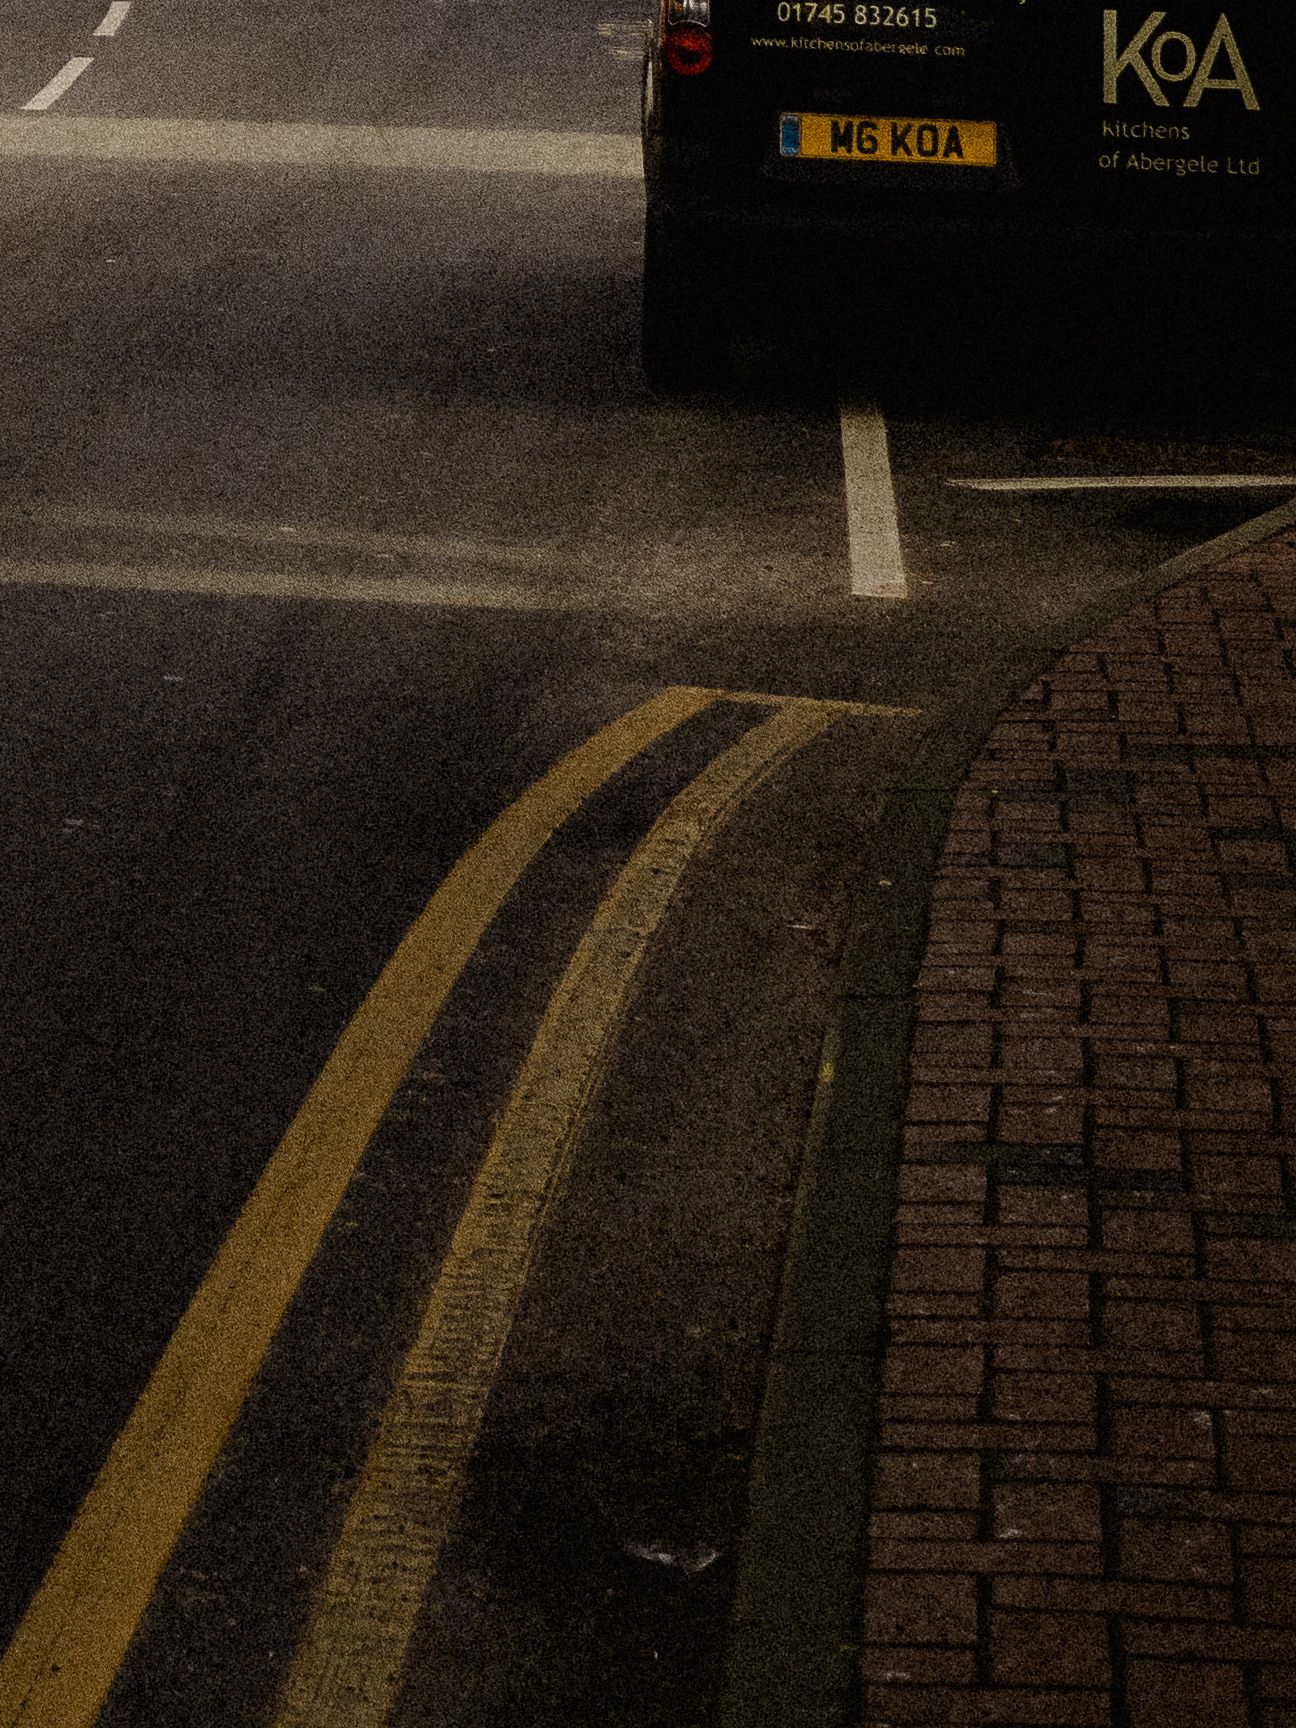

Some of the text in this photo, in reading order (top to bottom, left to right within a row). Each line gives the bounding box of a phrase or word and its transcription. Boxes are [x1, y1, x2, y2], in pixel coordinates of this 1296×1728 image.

[777, 1, 937, 28] 01745 832615
[830, 119, 964, 159] M6 KOA
[1098, 151, 1260, 176] of Abergele Ltd
